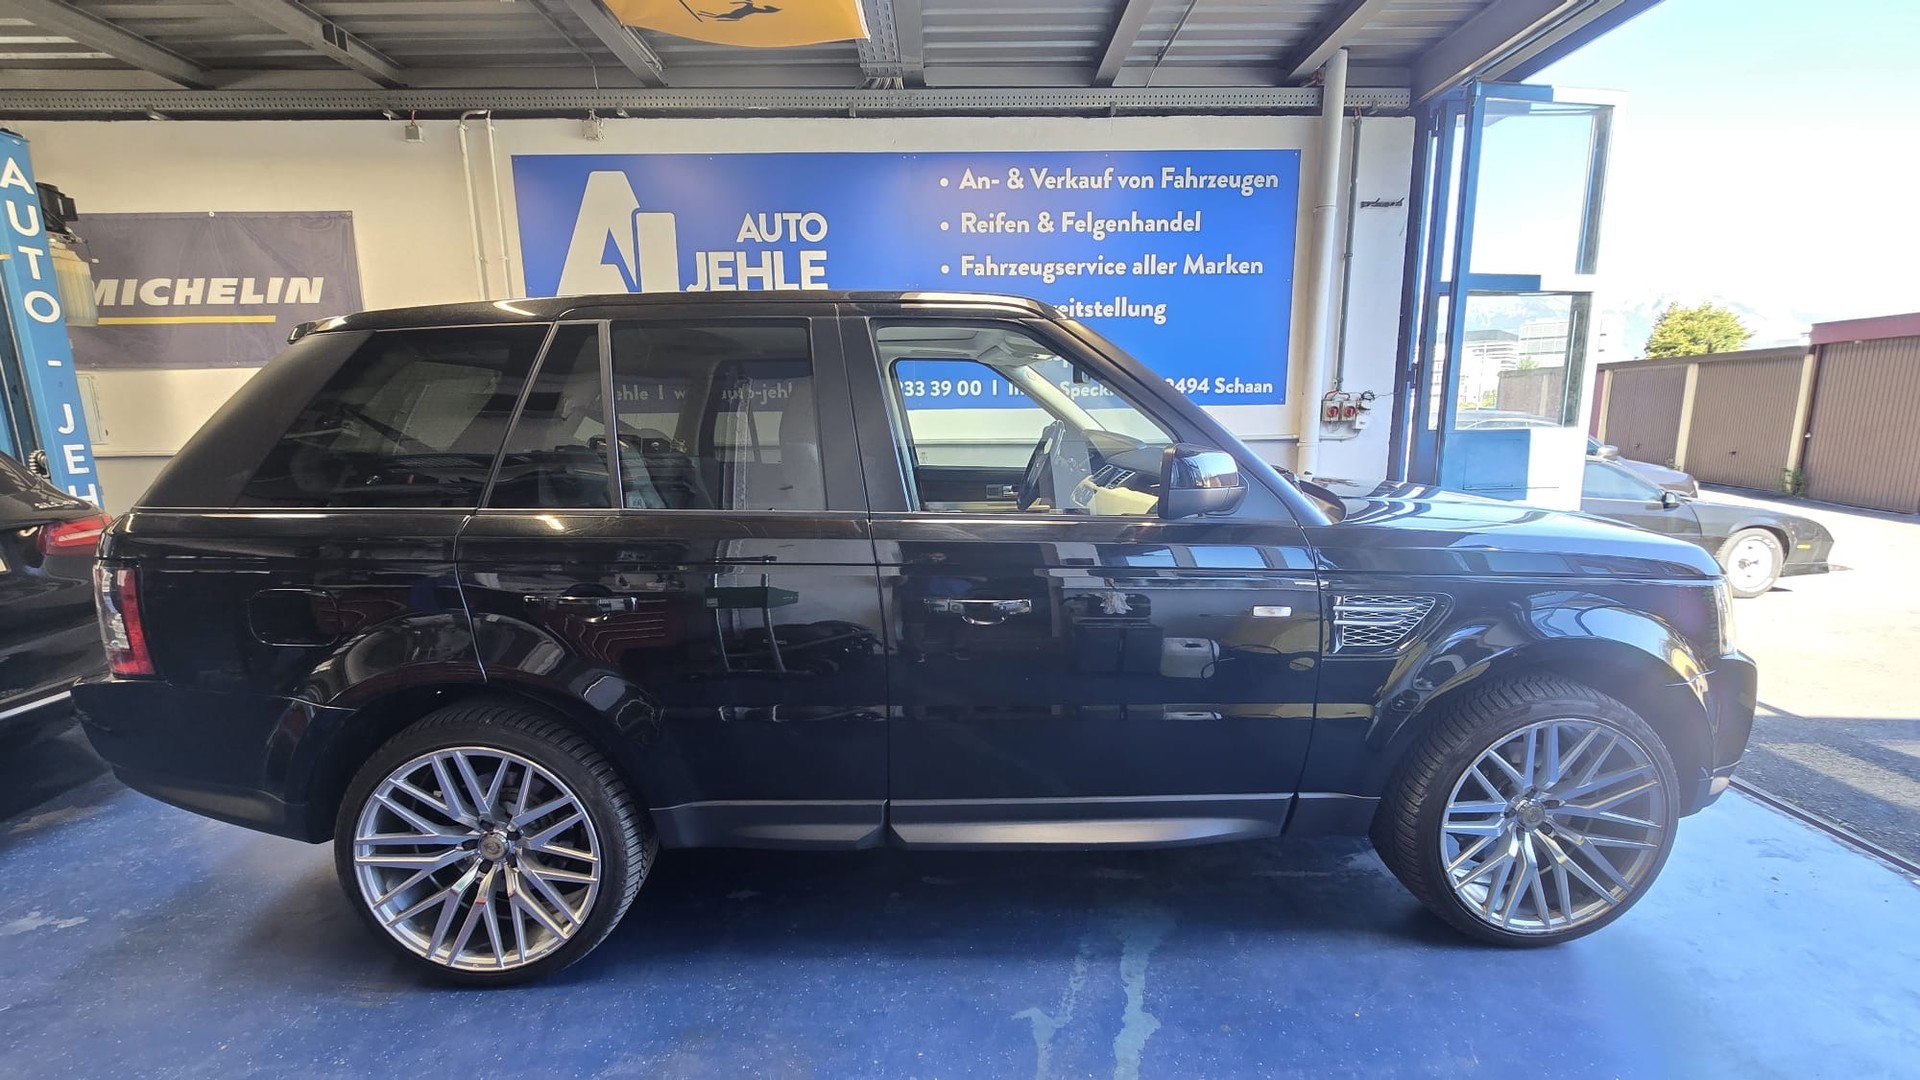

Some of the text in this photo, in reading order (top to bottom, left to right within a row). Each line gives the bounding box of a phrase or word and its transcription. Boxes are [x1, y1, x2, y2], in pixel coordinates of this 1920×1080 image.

[958, 167, 1279, 197] An- & Verkauf von Fahrzeugen
[736, 212, 828, 243] AUTO
[960, 211, 1202, 241] Reifen & Felgenhandel
[686, 250, 829, 291] JEHLE
[960, 253, 1264, 284] Fahrzeugservice aller Marken
[1051, 296, 1167, 326] eitstellung
[900, 380, 925, 397] 33
[930, 380, 952, 397] 39
[957, 380, 982, 397] 00
[1214, 376, 1274, 394] Schaan
